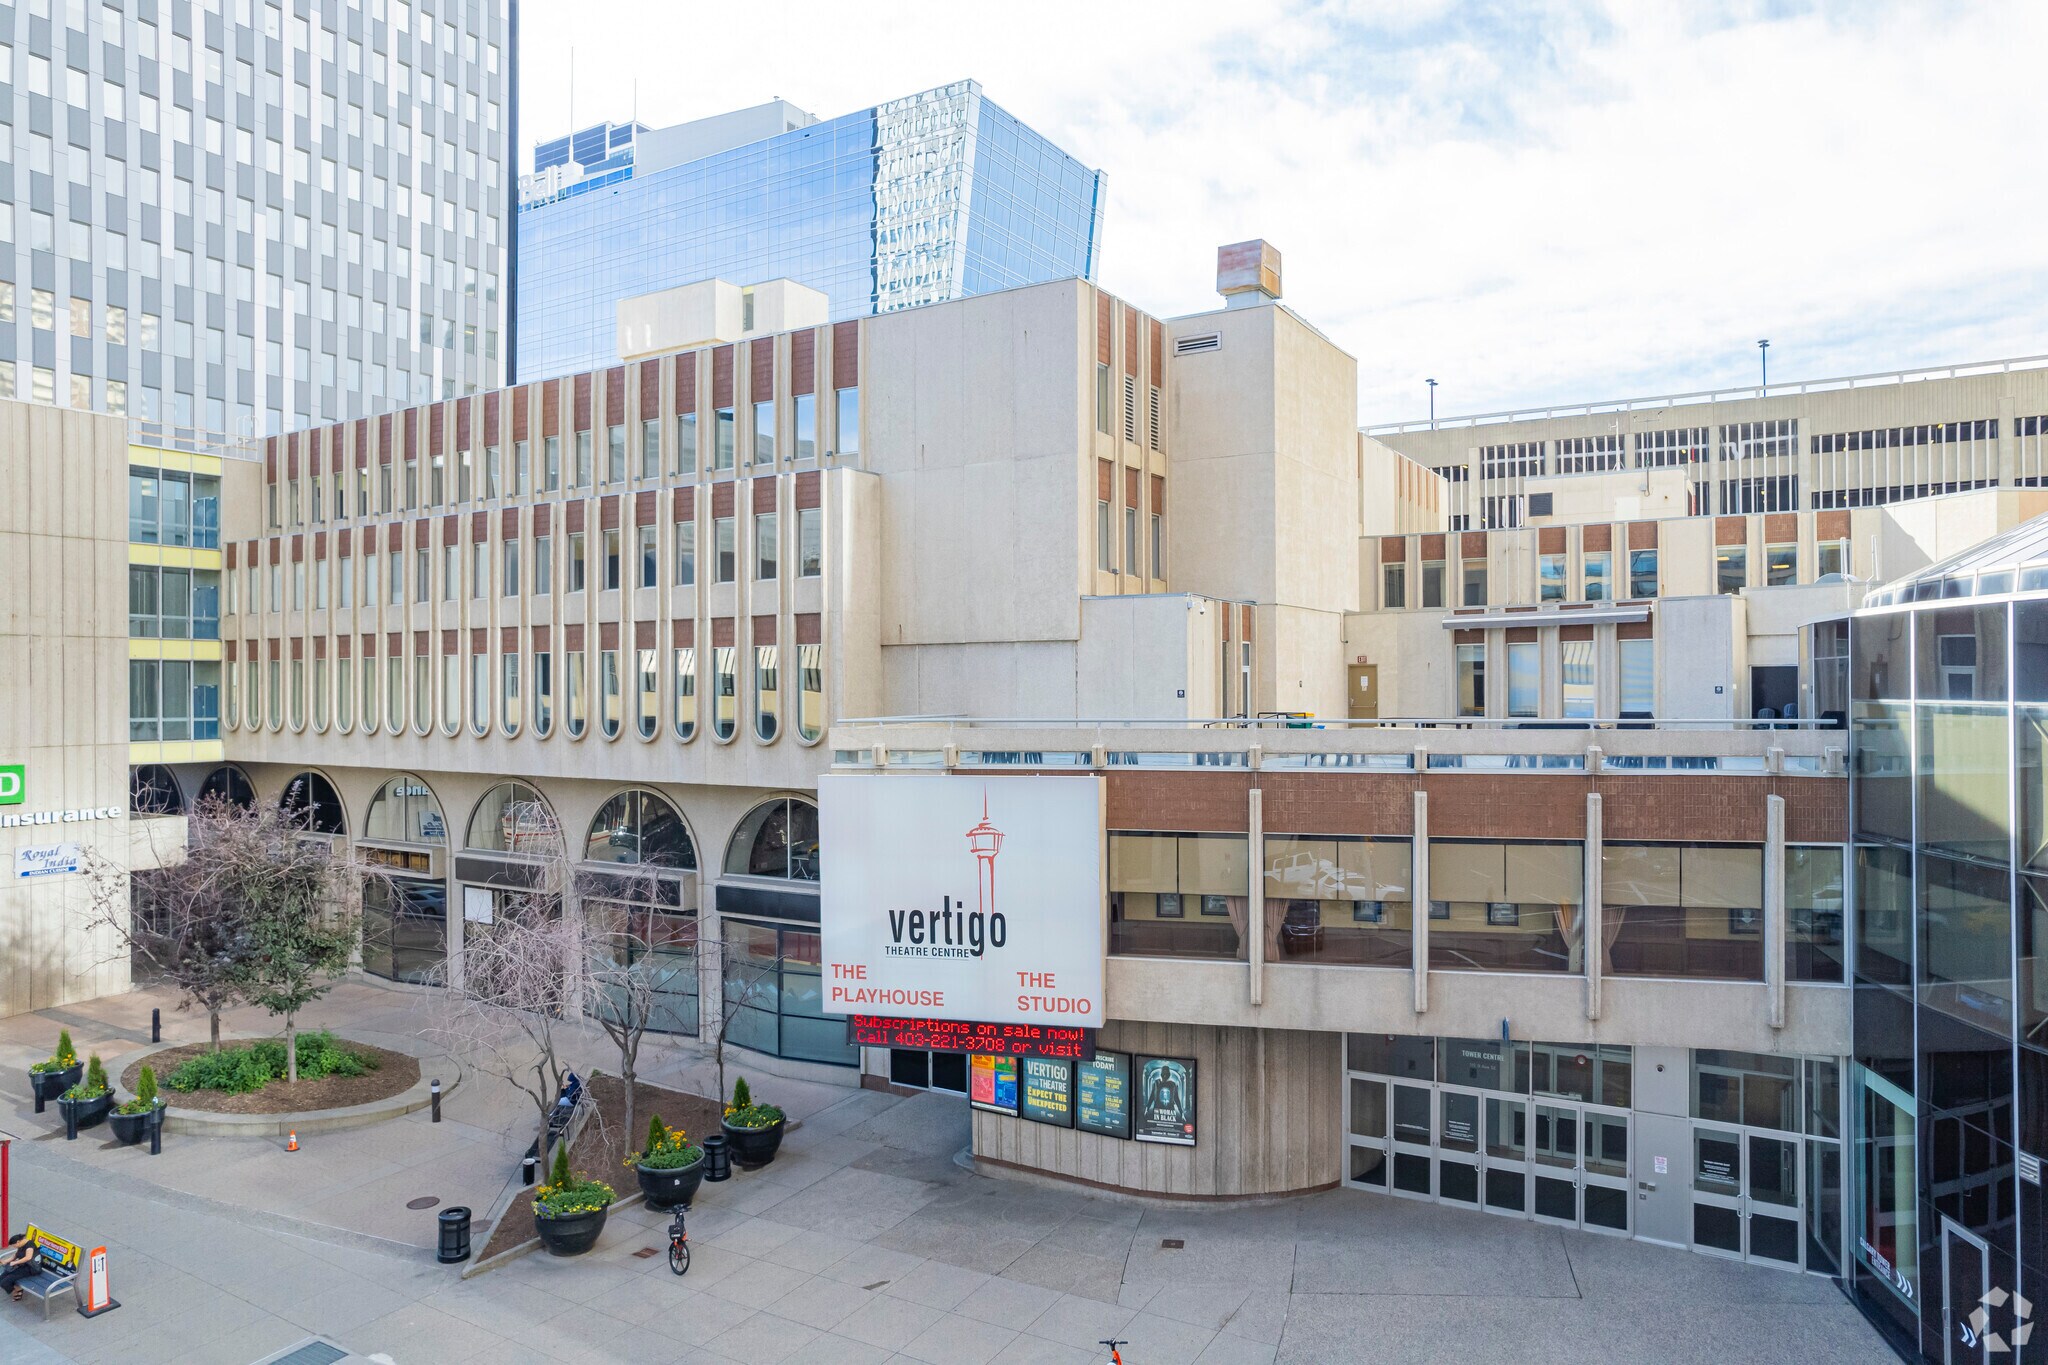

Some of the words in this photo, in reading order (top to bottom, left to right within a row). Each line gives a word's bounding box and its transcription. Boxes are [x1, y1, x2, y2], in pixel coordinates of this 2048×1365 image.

[0, 772, 20, 796] D
[0, 806, 122, 828] nsurance
[21, 845, 61, 861] Royal
[42, 856, 77, 868] India
[888, 895, 1007, 957] vertigo
[885, 946, 928, 956] THEATRE
[931, 947, 970, 958] CENTRE
[831, 963, 867, 980] THE
[1017, 972, 1056, 988] THE
[832, 987, 944, 1007] PLAYHOUSE
[1018, 995, 1092, 1014] STUDIO
[853, 1014, 970, 1035] Subscriptions
[977, 1024, 996, 1036] on
[1003, 1023, 1040, 1039] sale
[1047, 1027, 1084, 1042] now!
[856, 1029, 889, 1044] Call
[895, 1032, 1004, 1052] 403-221-3708
[1012, 1041, 1032, 1053] or
[1039, 1042, 1082, 1057] visit
[1461, 1050, 1482, 1060] TOWER
[1483, 1052, 1504, 1061] CENTRE
[1027, 1061, 1067, 1081] VERTIGO
[1039, 1078, 1067, 1092] THEATRE
[1027, 1086, 1053, 1099] EXPECT
[1054, 1092, 1067, 1103] THE
[1027, 1096, 1067, 1112] UNEXPECTED
